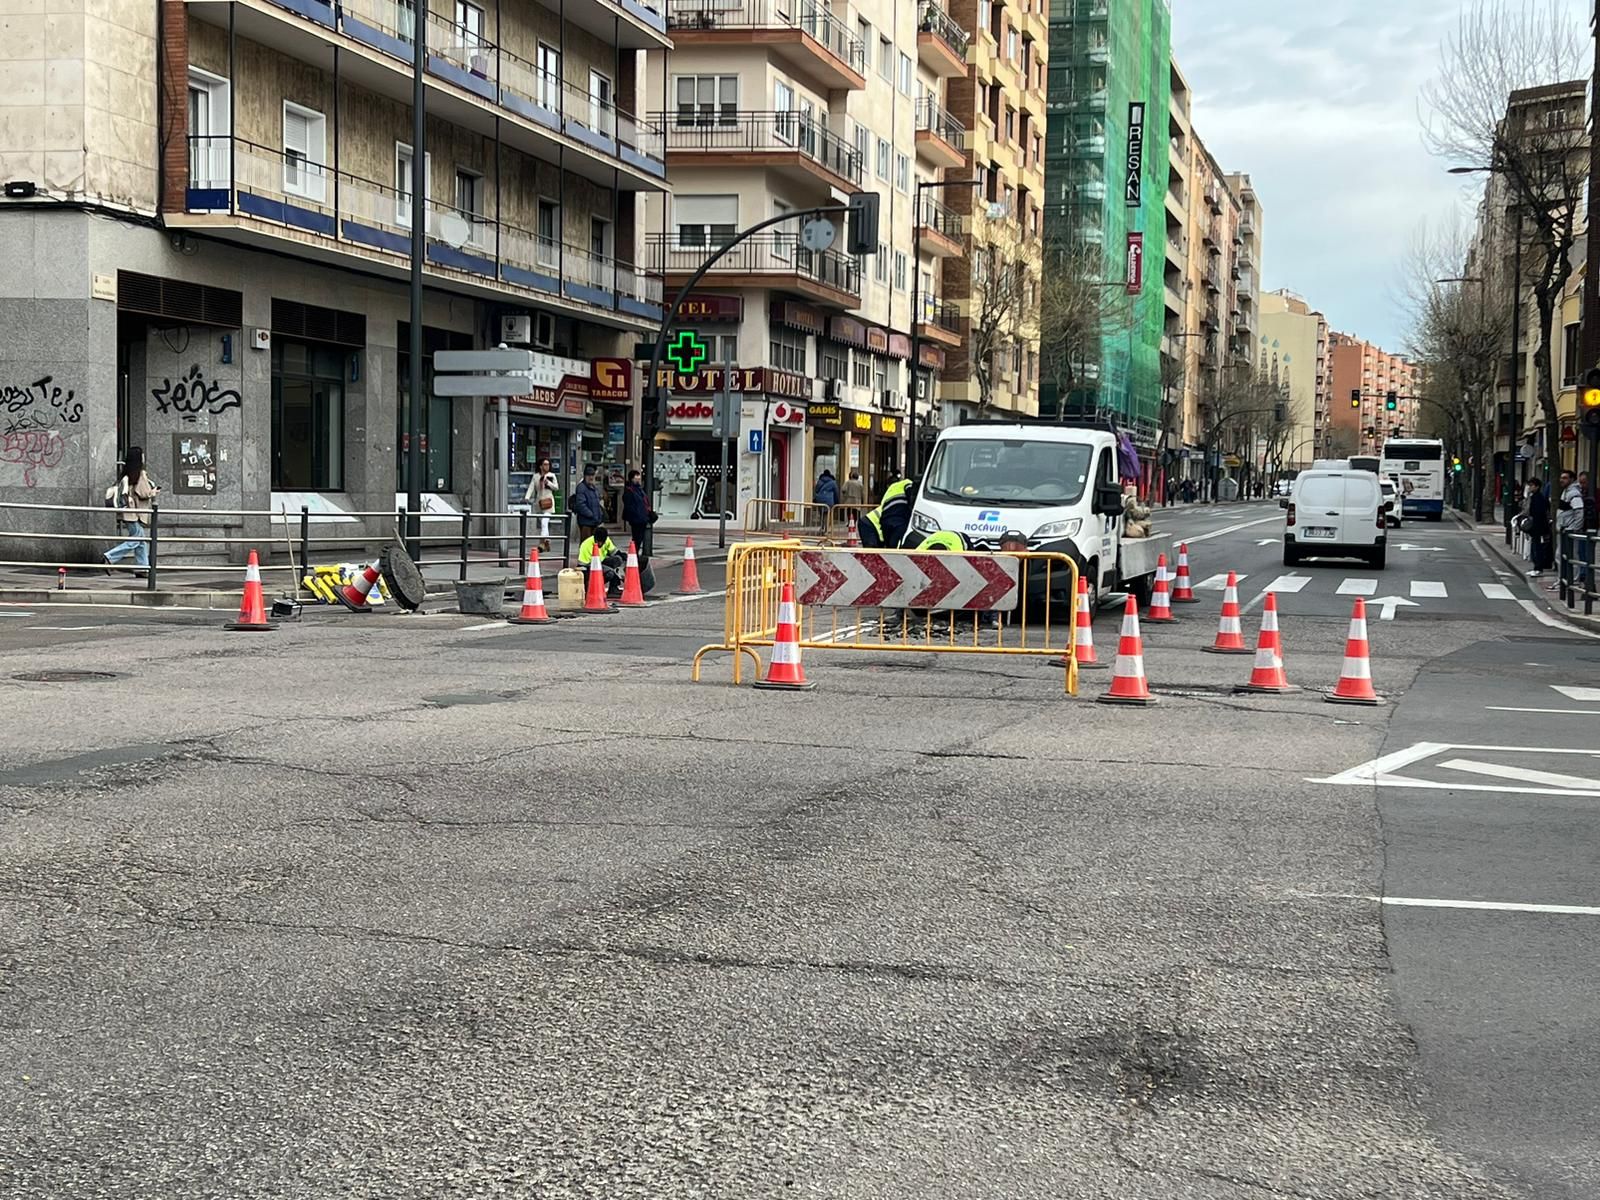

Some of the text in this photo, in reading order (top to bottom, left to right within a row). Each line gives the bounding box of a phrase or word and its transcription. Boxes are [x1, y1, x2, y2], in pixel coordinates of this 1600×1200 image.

[1127, 126, 1141, 199] RESAN
[663, 302, 712, 314] OTEL
[656, 369, 761, 391] HOTEL
[772, 371, 802, 397] HOTEL
[591, 389, 629, 398] TABACOS
[666, 402, 714, 419] odafo
[809, 405, 837, 415] GADIS
